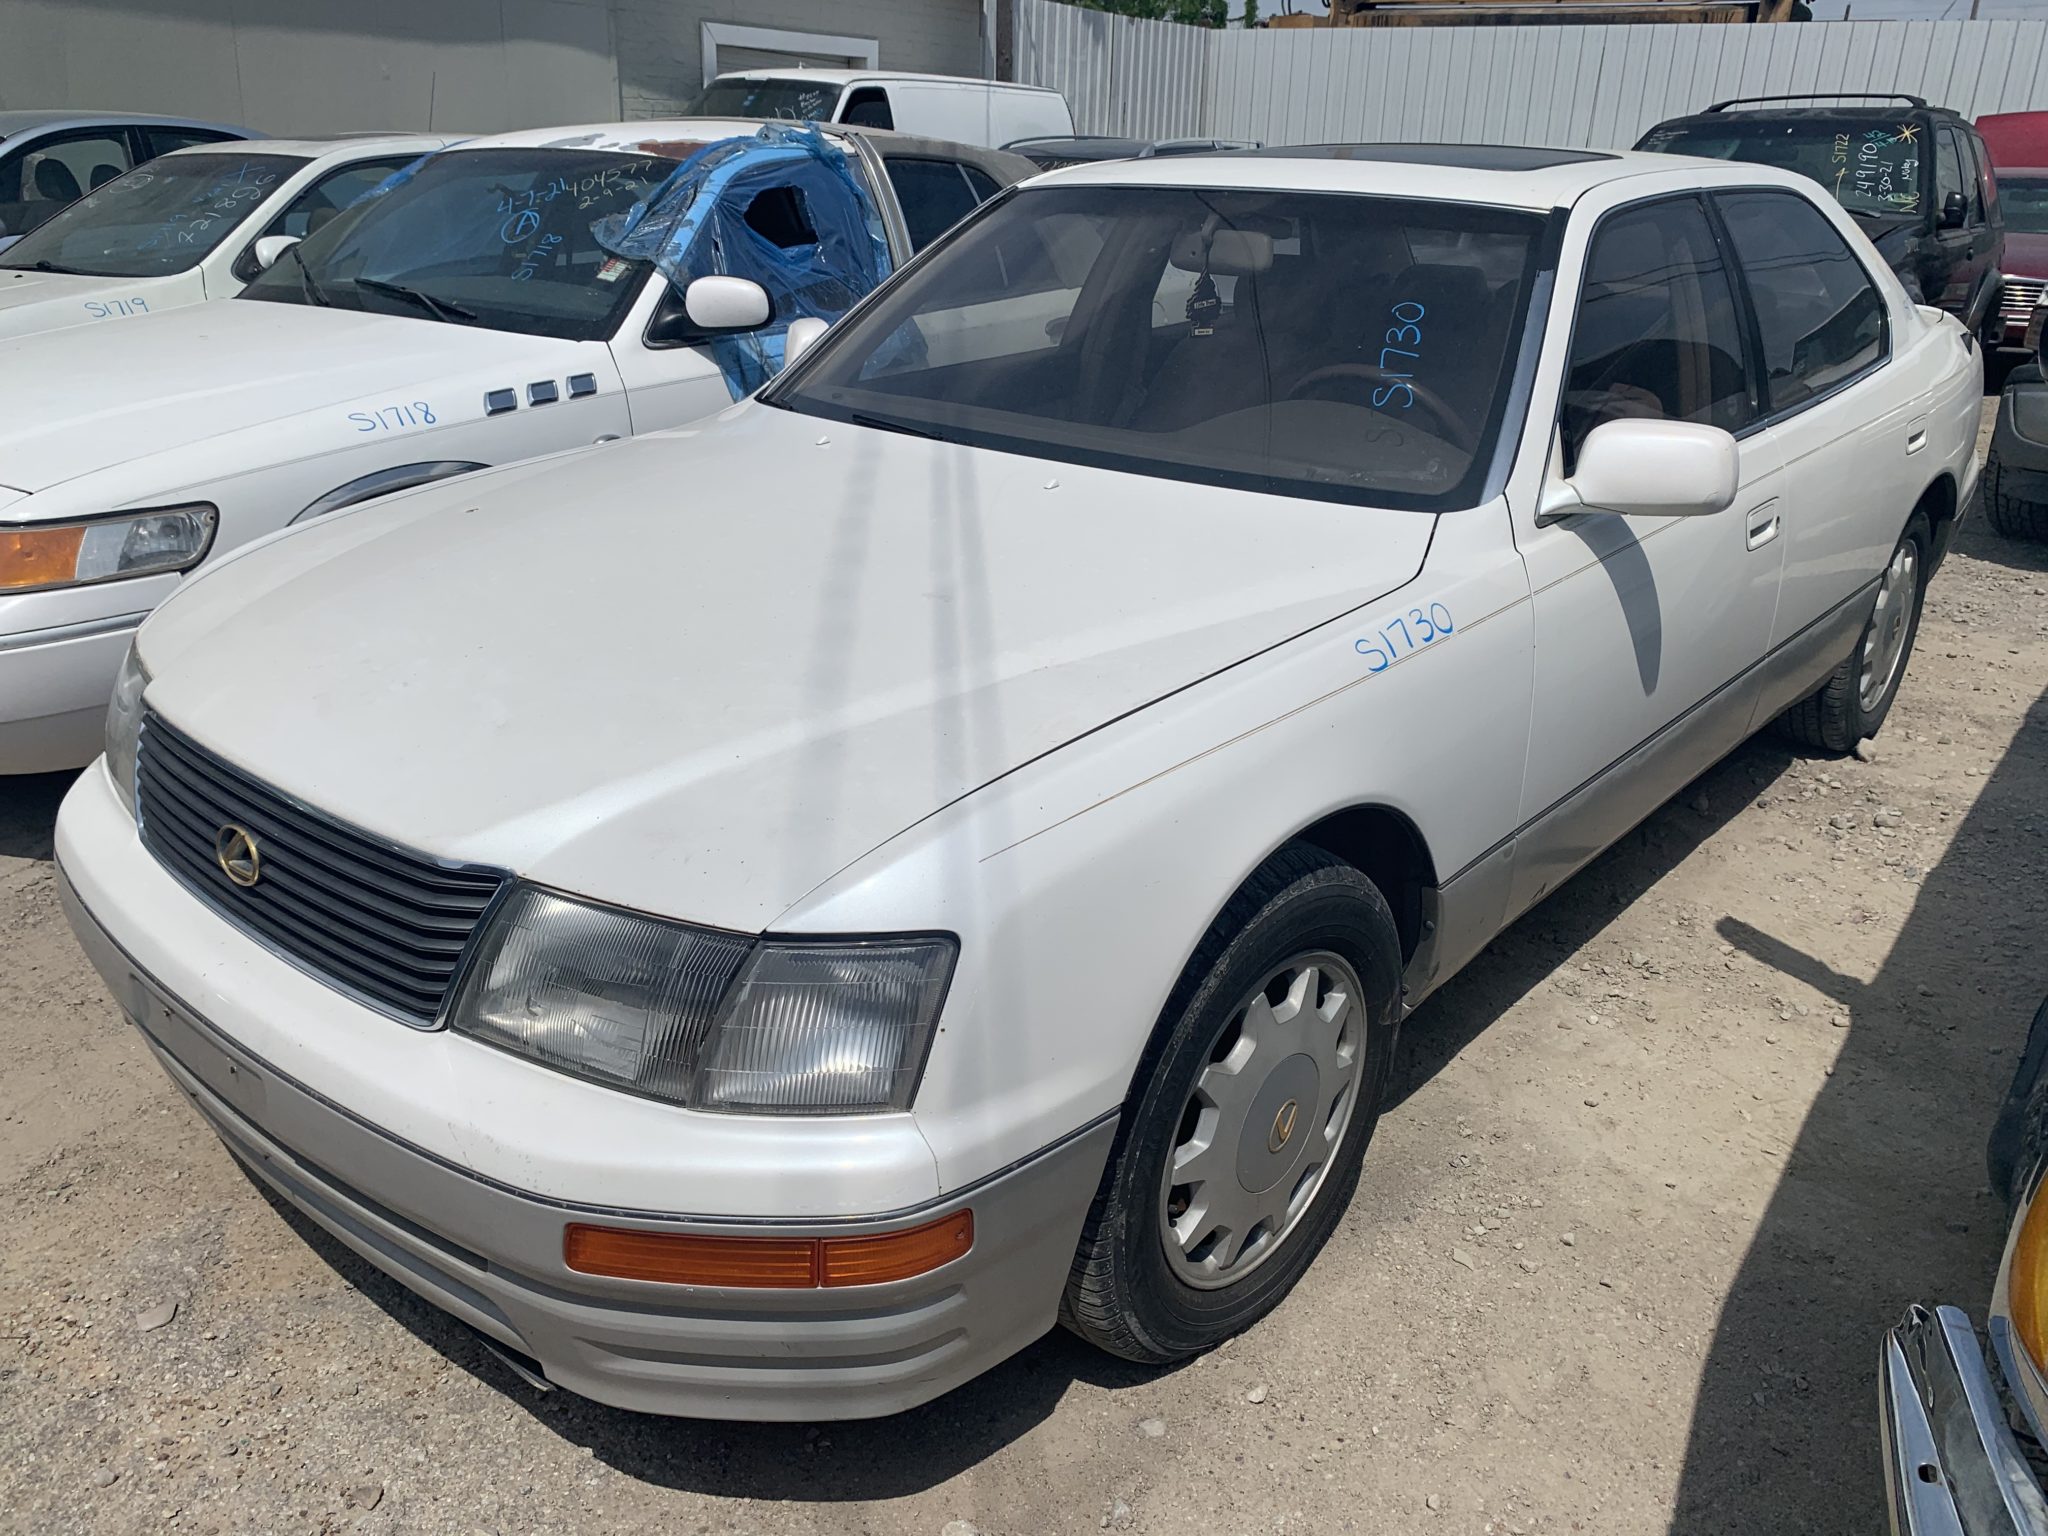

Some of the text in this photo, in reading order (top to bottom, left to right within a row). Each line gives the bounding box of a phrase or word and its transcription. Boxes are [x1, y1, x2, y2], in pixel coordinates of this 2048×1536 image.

[1831, 132, 1850, 164] S1722
[566, 159, 653, 196] 404577
[1855, 142, 1878, 197] 249190
[511, 233, 563, 281] S1718
[84, 297, 149, 318] S1719
[1372, 301, 1425, 408] S1730
[347, 401, 437, 432] S1718
[1354, 602, 1454, 672] S1730
